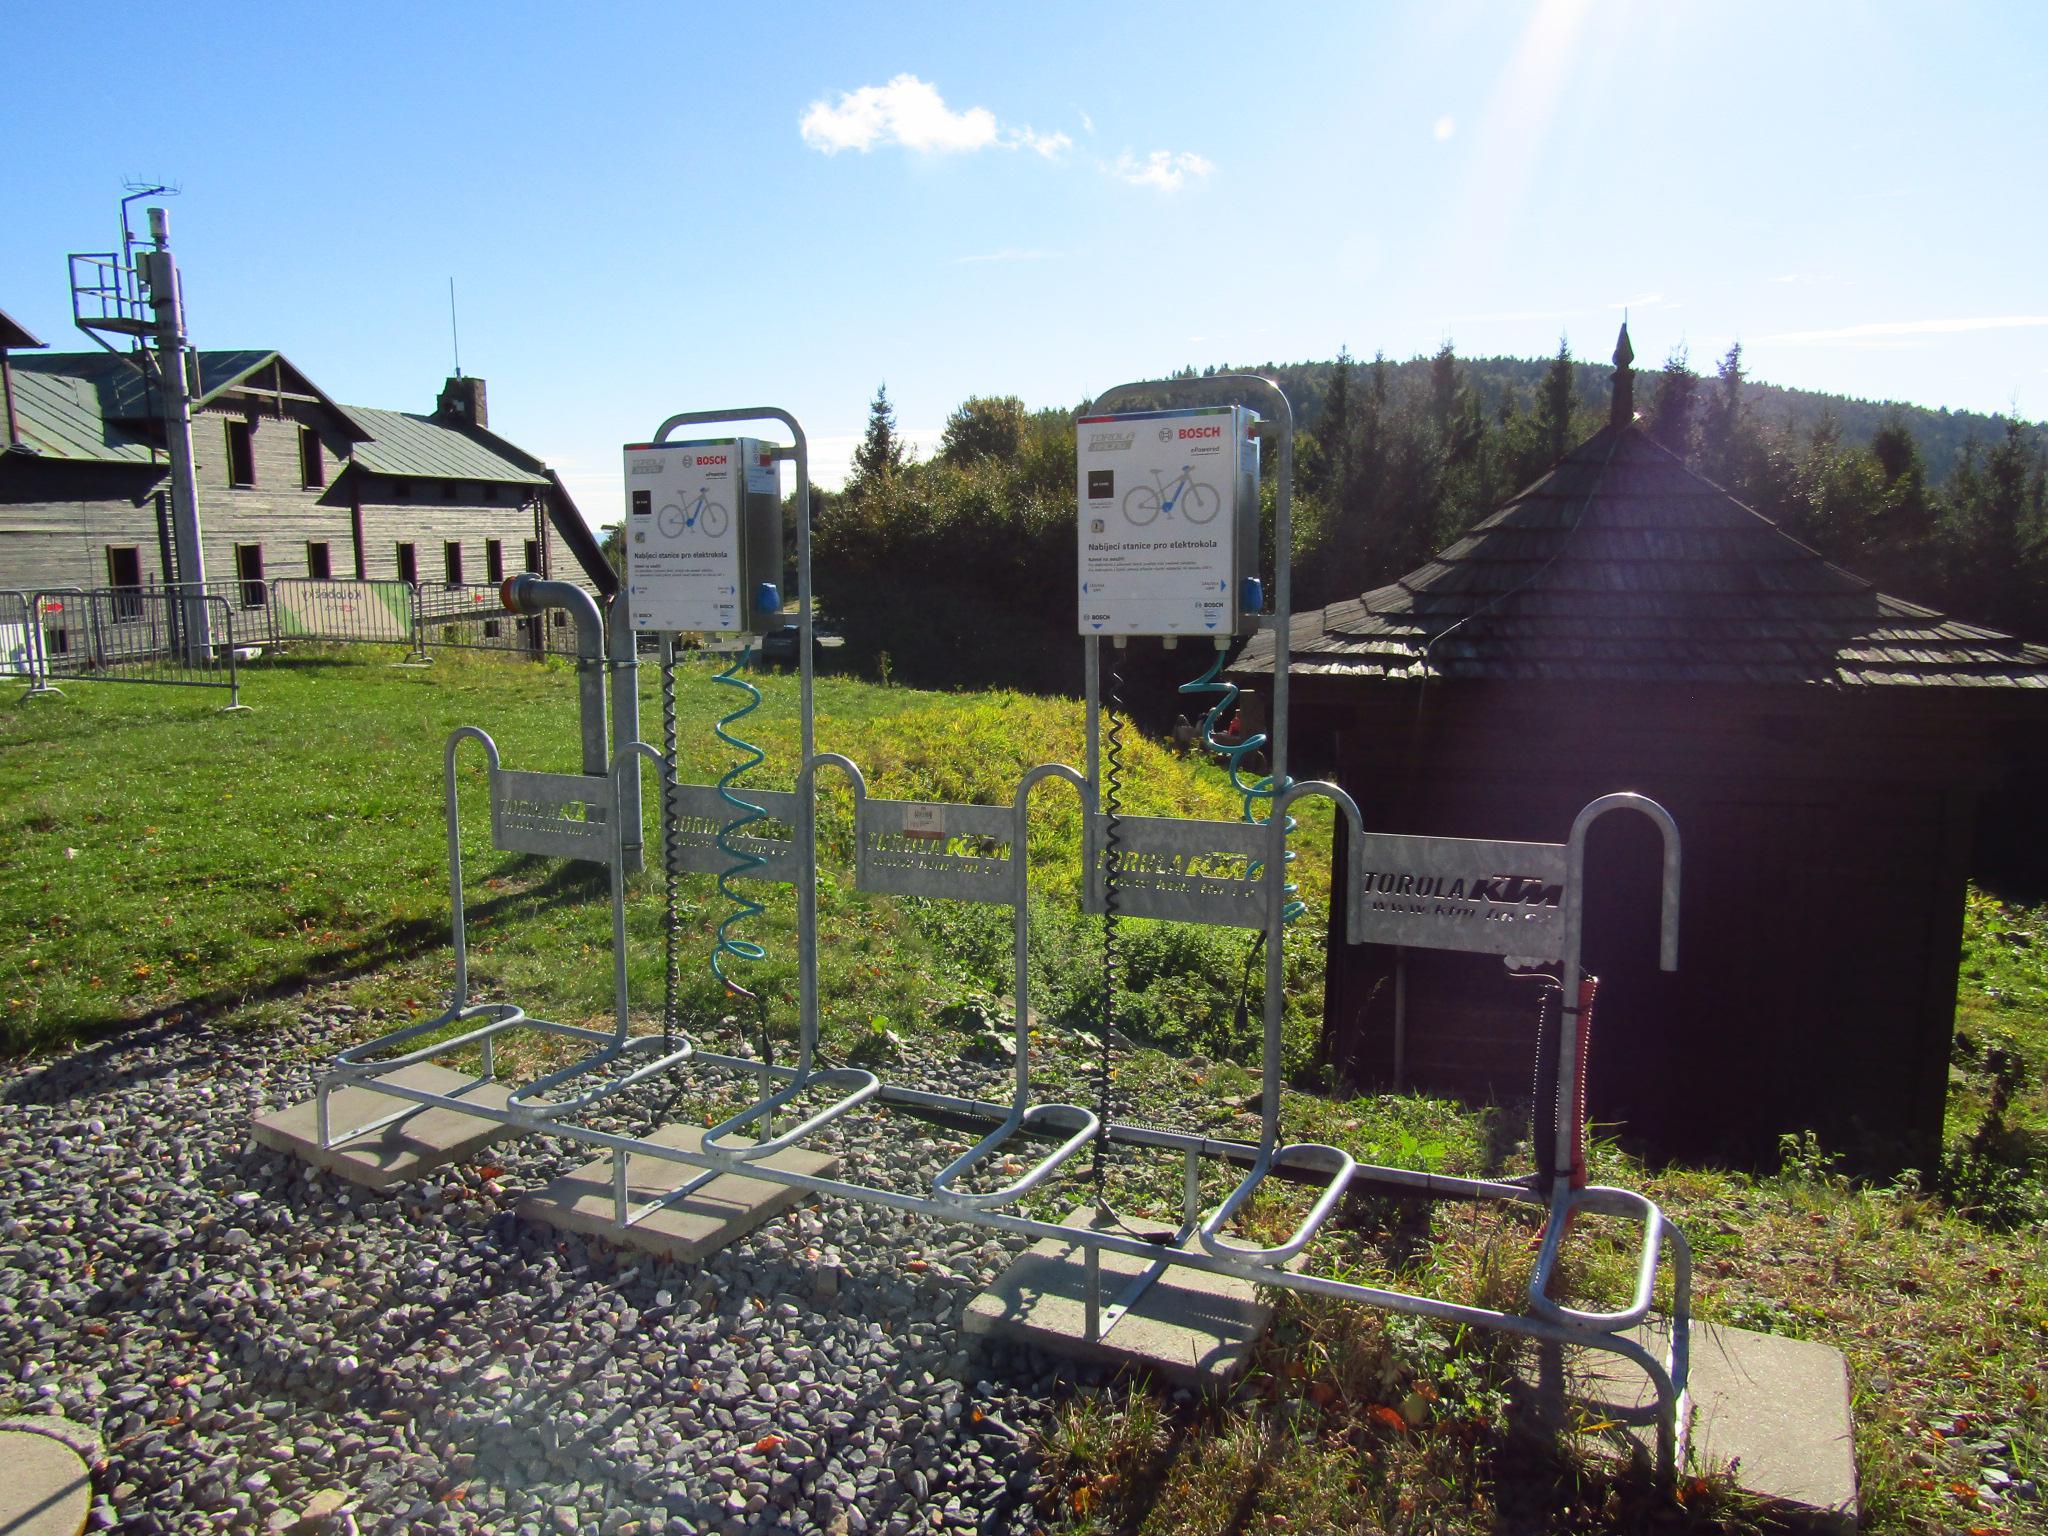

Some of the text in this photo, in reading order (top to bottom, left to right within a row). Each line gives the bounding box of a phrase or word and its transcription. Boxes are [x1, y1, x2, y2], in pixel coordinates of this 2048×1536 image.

[1178, 426, 1221, 439] BOSCH
[1190, 446, 1220, 454] ePowered
[697, 455, 727, 465] BOSCH
[1088, 539, 1217, 552] Nabíjecí stanice pro elektrokola
[659, 551, 680, 559] stanice
[681, 552, 692, 560] pro
[1363, 871, 1564, 909] TOROLA KTM
